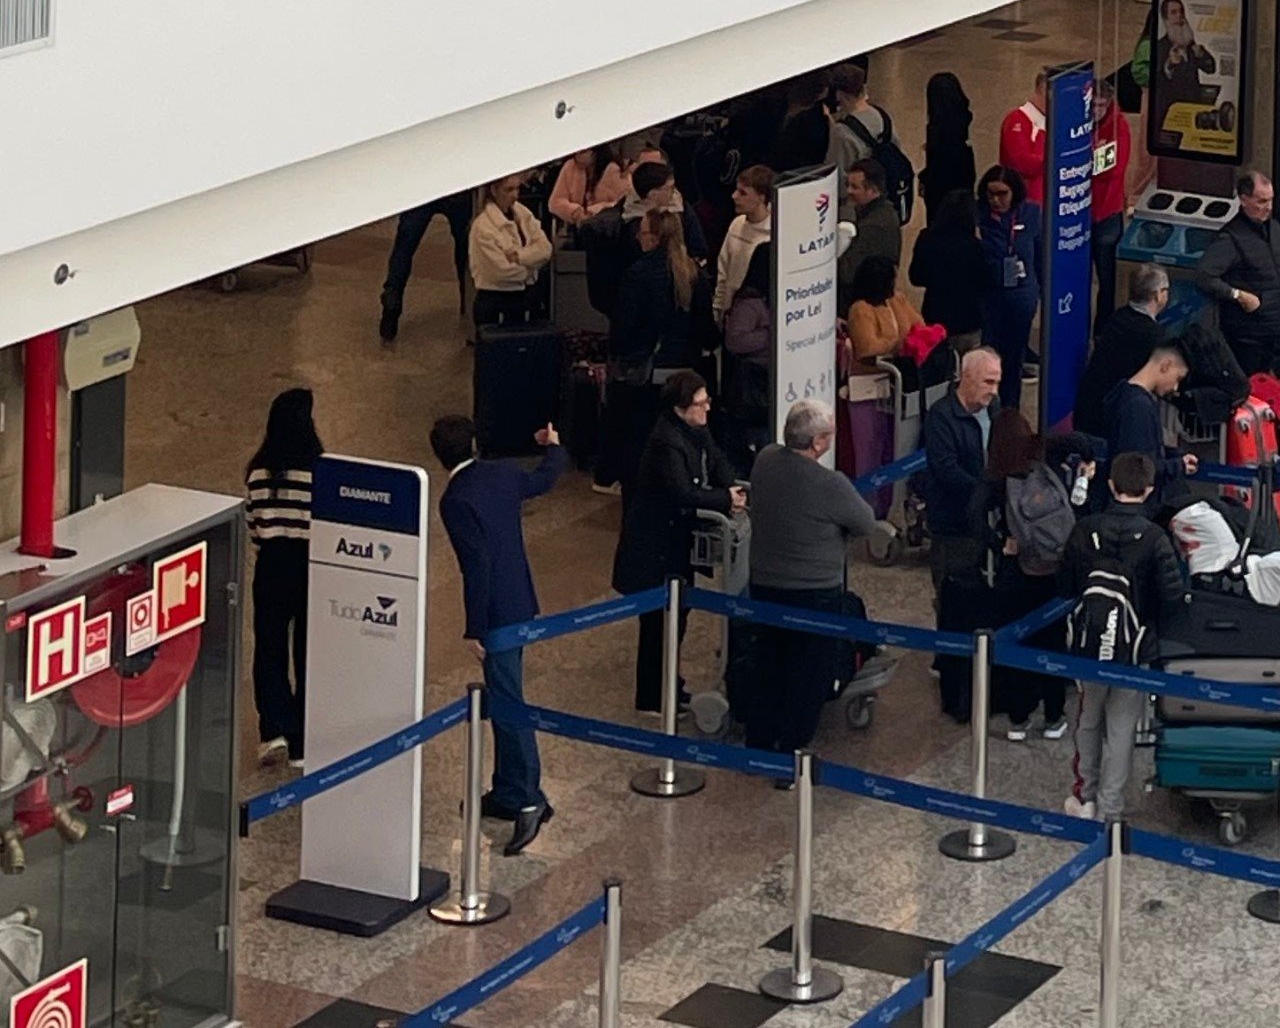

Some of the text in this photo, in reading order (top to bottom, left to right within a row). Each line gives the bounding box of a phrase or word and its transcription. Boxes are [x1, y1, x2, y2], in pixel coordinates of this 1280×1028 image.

[785, 309, 806, 327] por
[338, 485, 392, 505] DIAMANTE
[335, 537, 374, 560] Azul
[1098, 605, 1119, 662] Wilson
[37, 611, 75, 687] H
